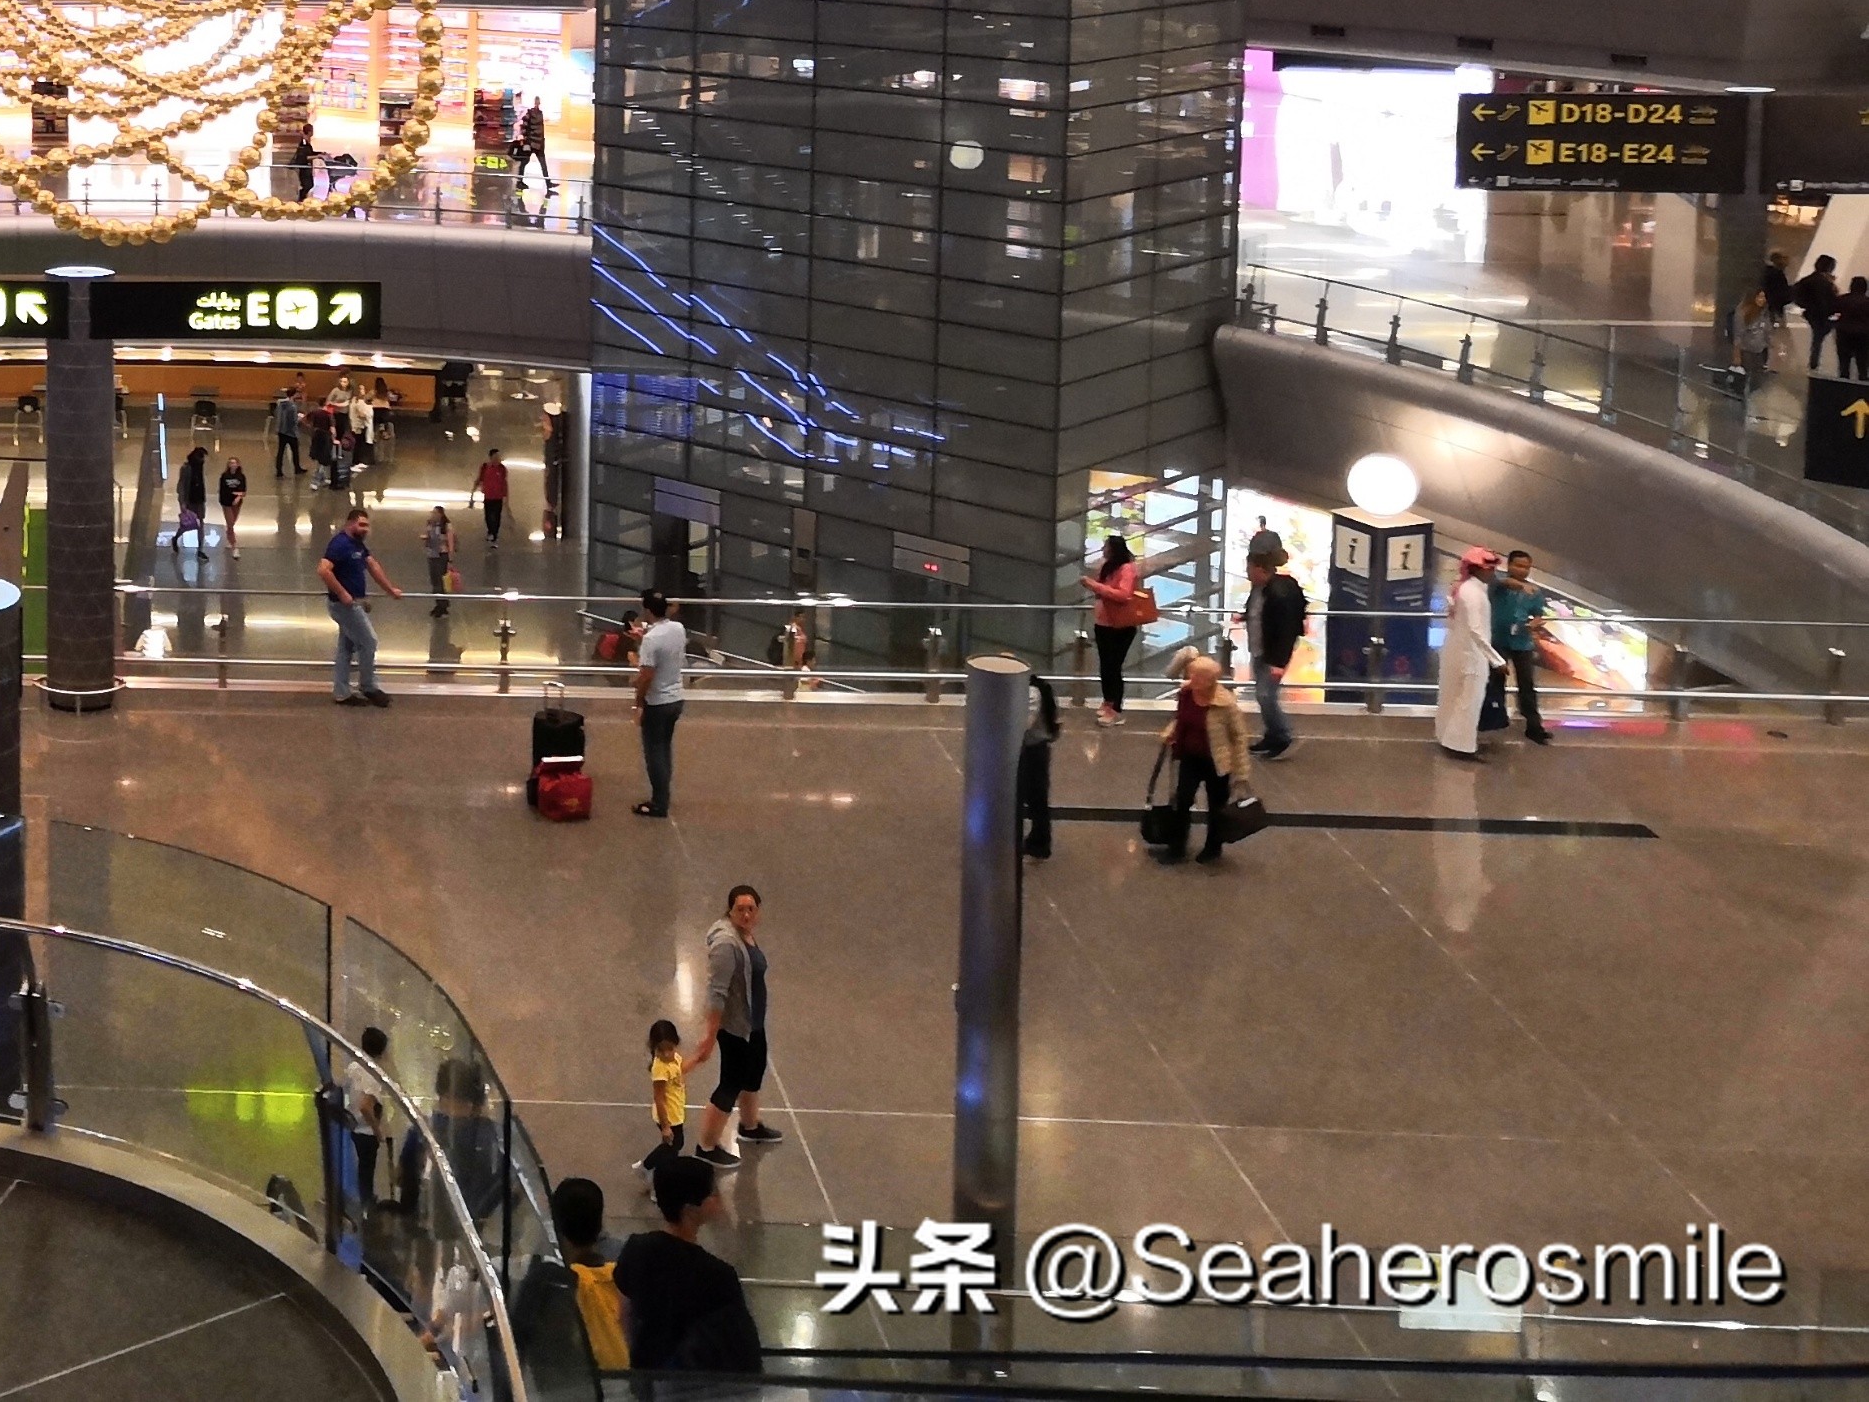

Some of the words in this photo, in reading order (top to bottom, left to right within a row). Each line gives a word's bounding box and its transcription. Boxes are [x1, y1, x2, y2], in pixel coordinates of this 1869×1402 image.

[1560, 103, 1683, 124] D18-D24
[1559, 143, 1676, 164] E18-E24
[188, 312, 241, 330] Gates
[247, 291, 270, 326] E
